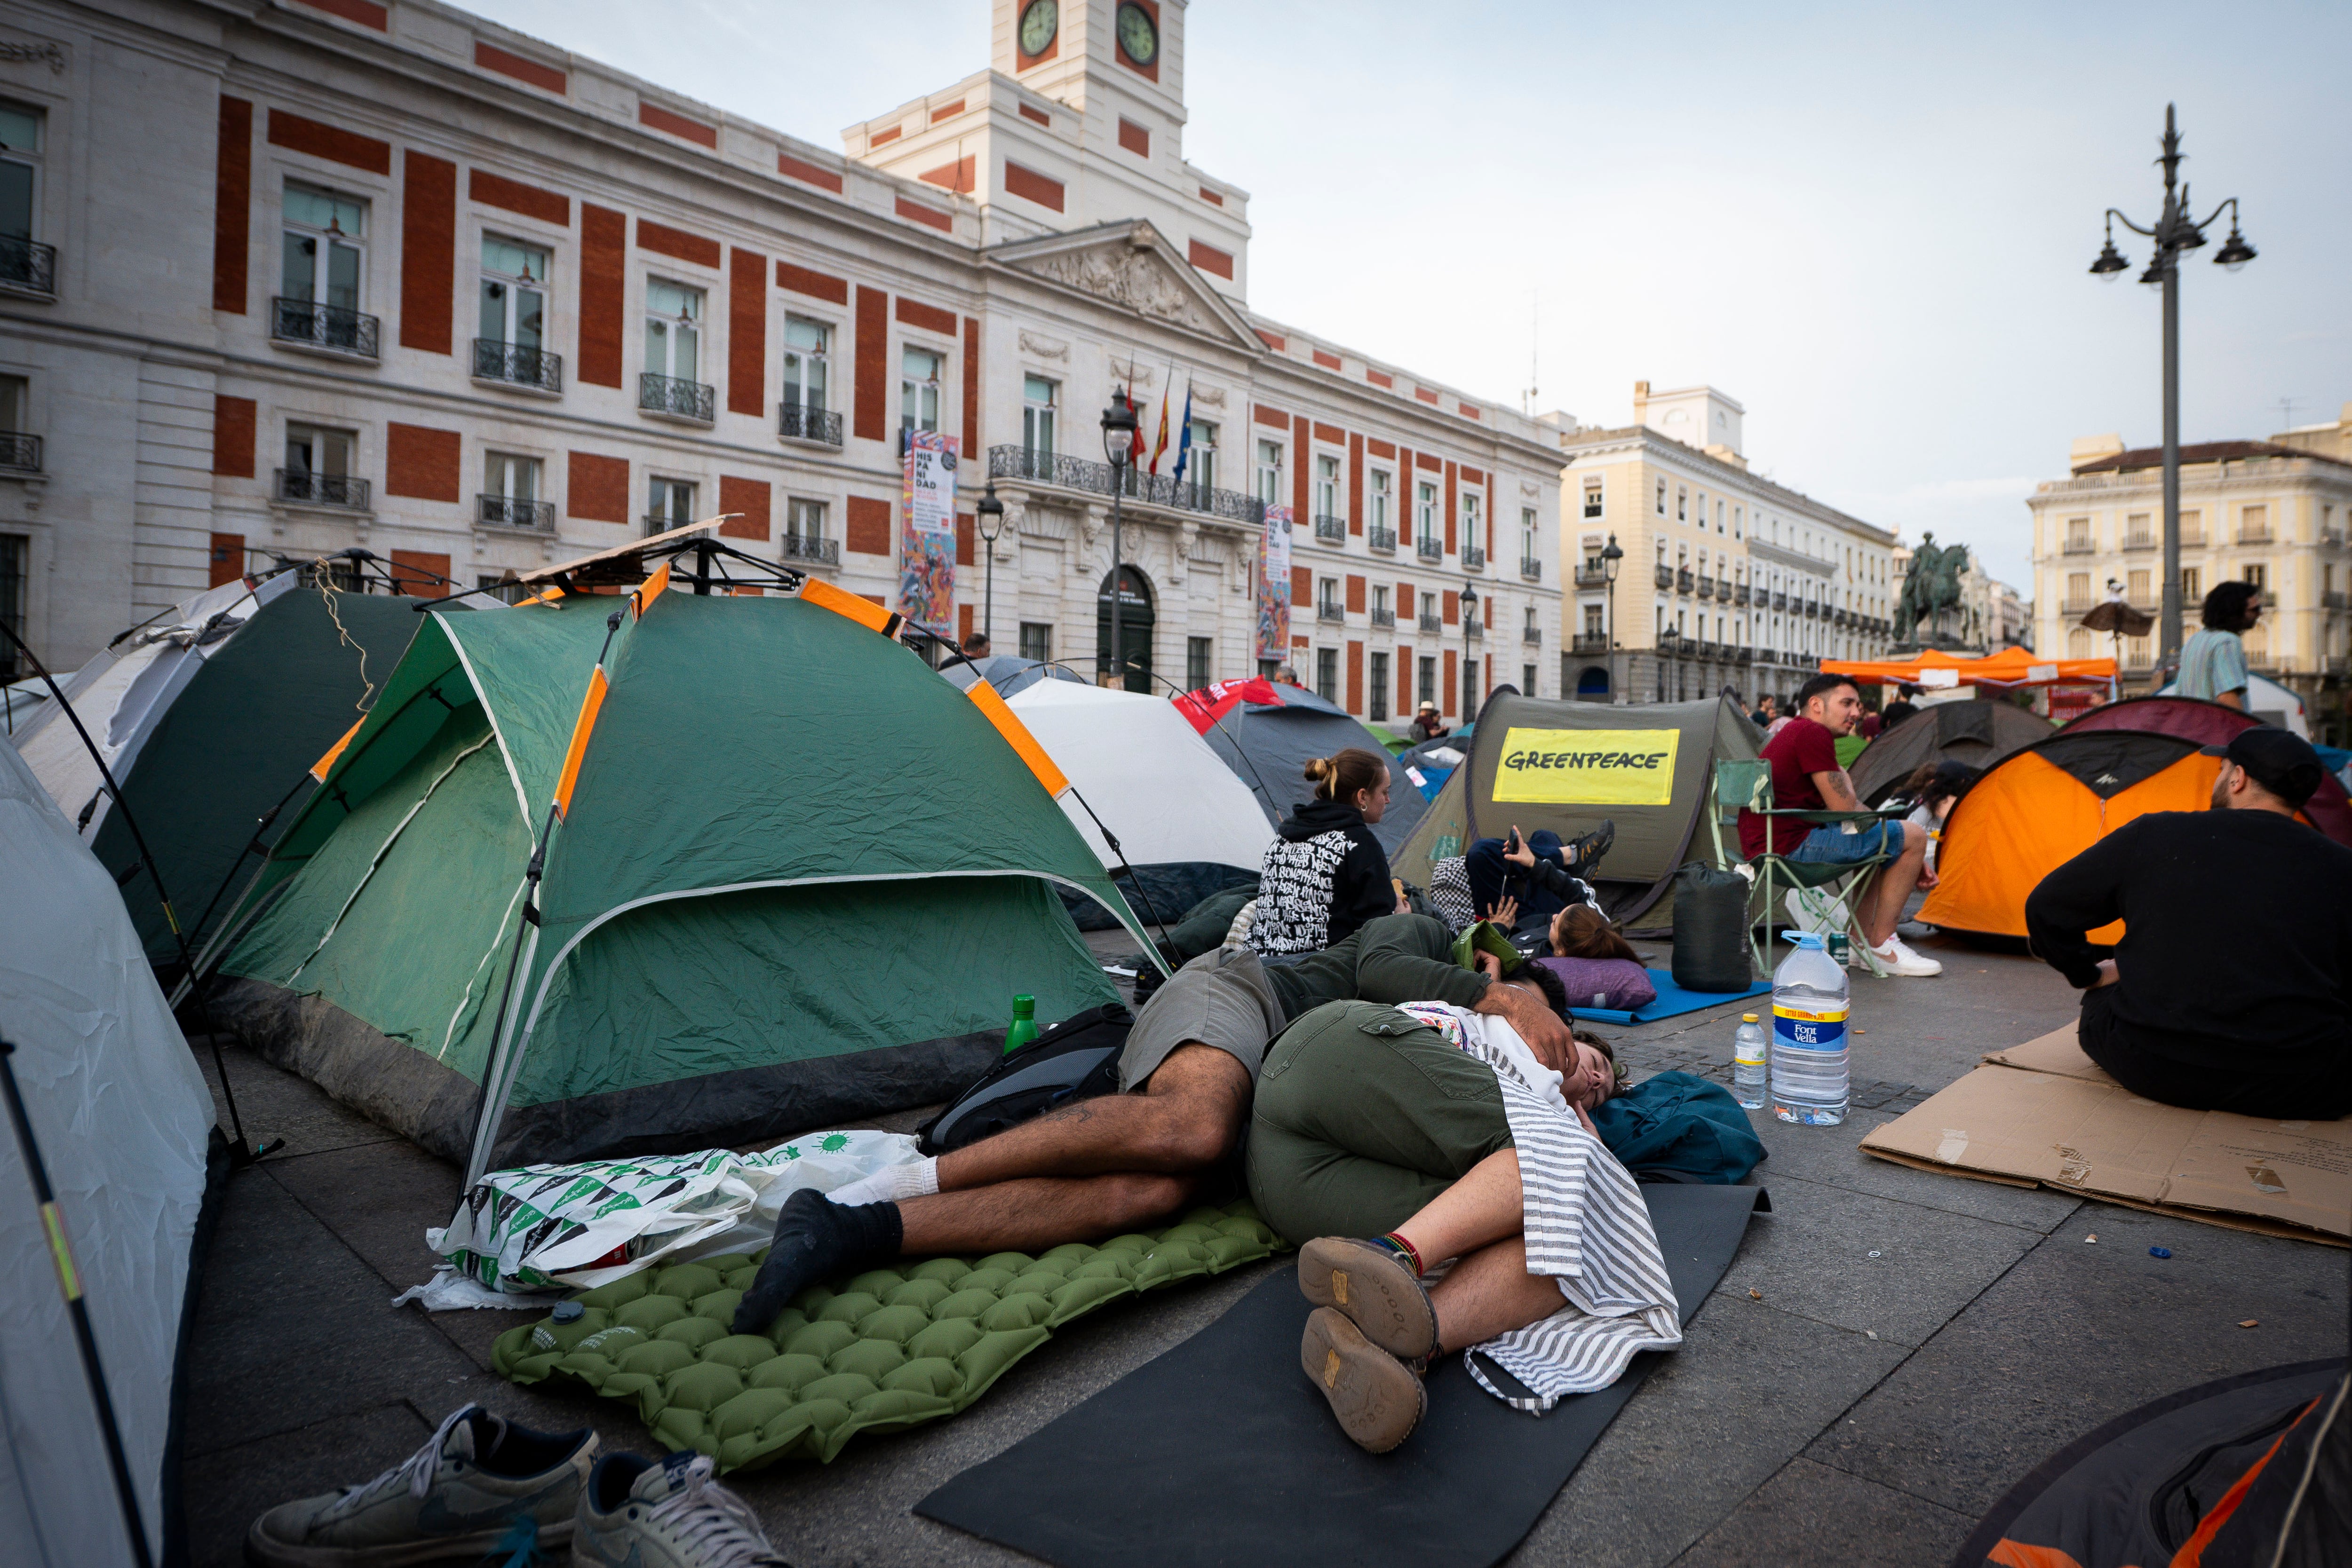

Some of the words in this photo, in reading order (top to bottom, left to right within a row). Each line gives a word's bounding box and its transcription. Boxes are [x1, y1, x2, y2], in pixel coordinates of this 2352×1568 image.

[916, 451, 932, 461] HIS
[917, 461, 928, 470] PA
[916, 480, 937, 489] DAD
[1505, 751, 1668, 771] GREENPEACE
[1795, 1024, 1817, 1035] Font
[1794, 1033, 1818, 1044] Vella
